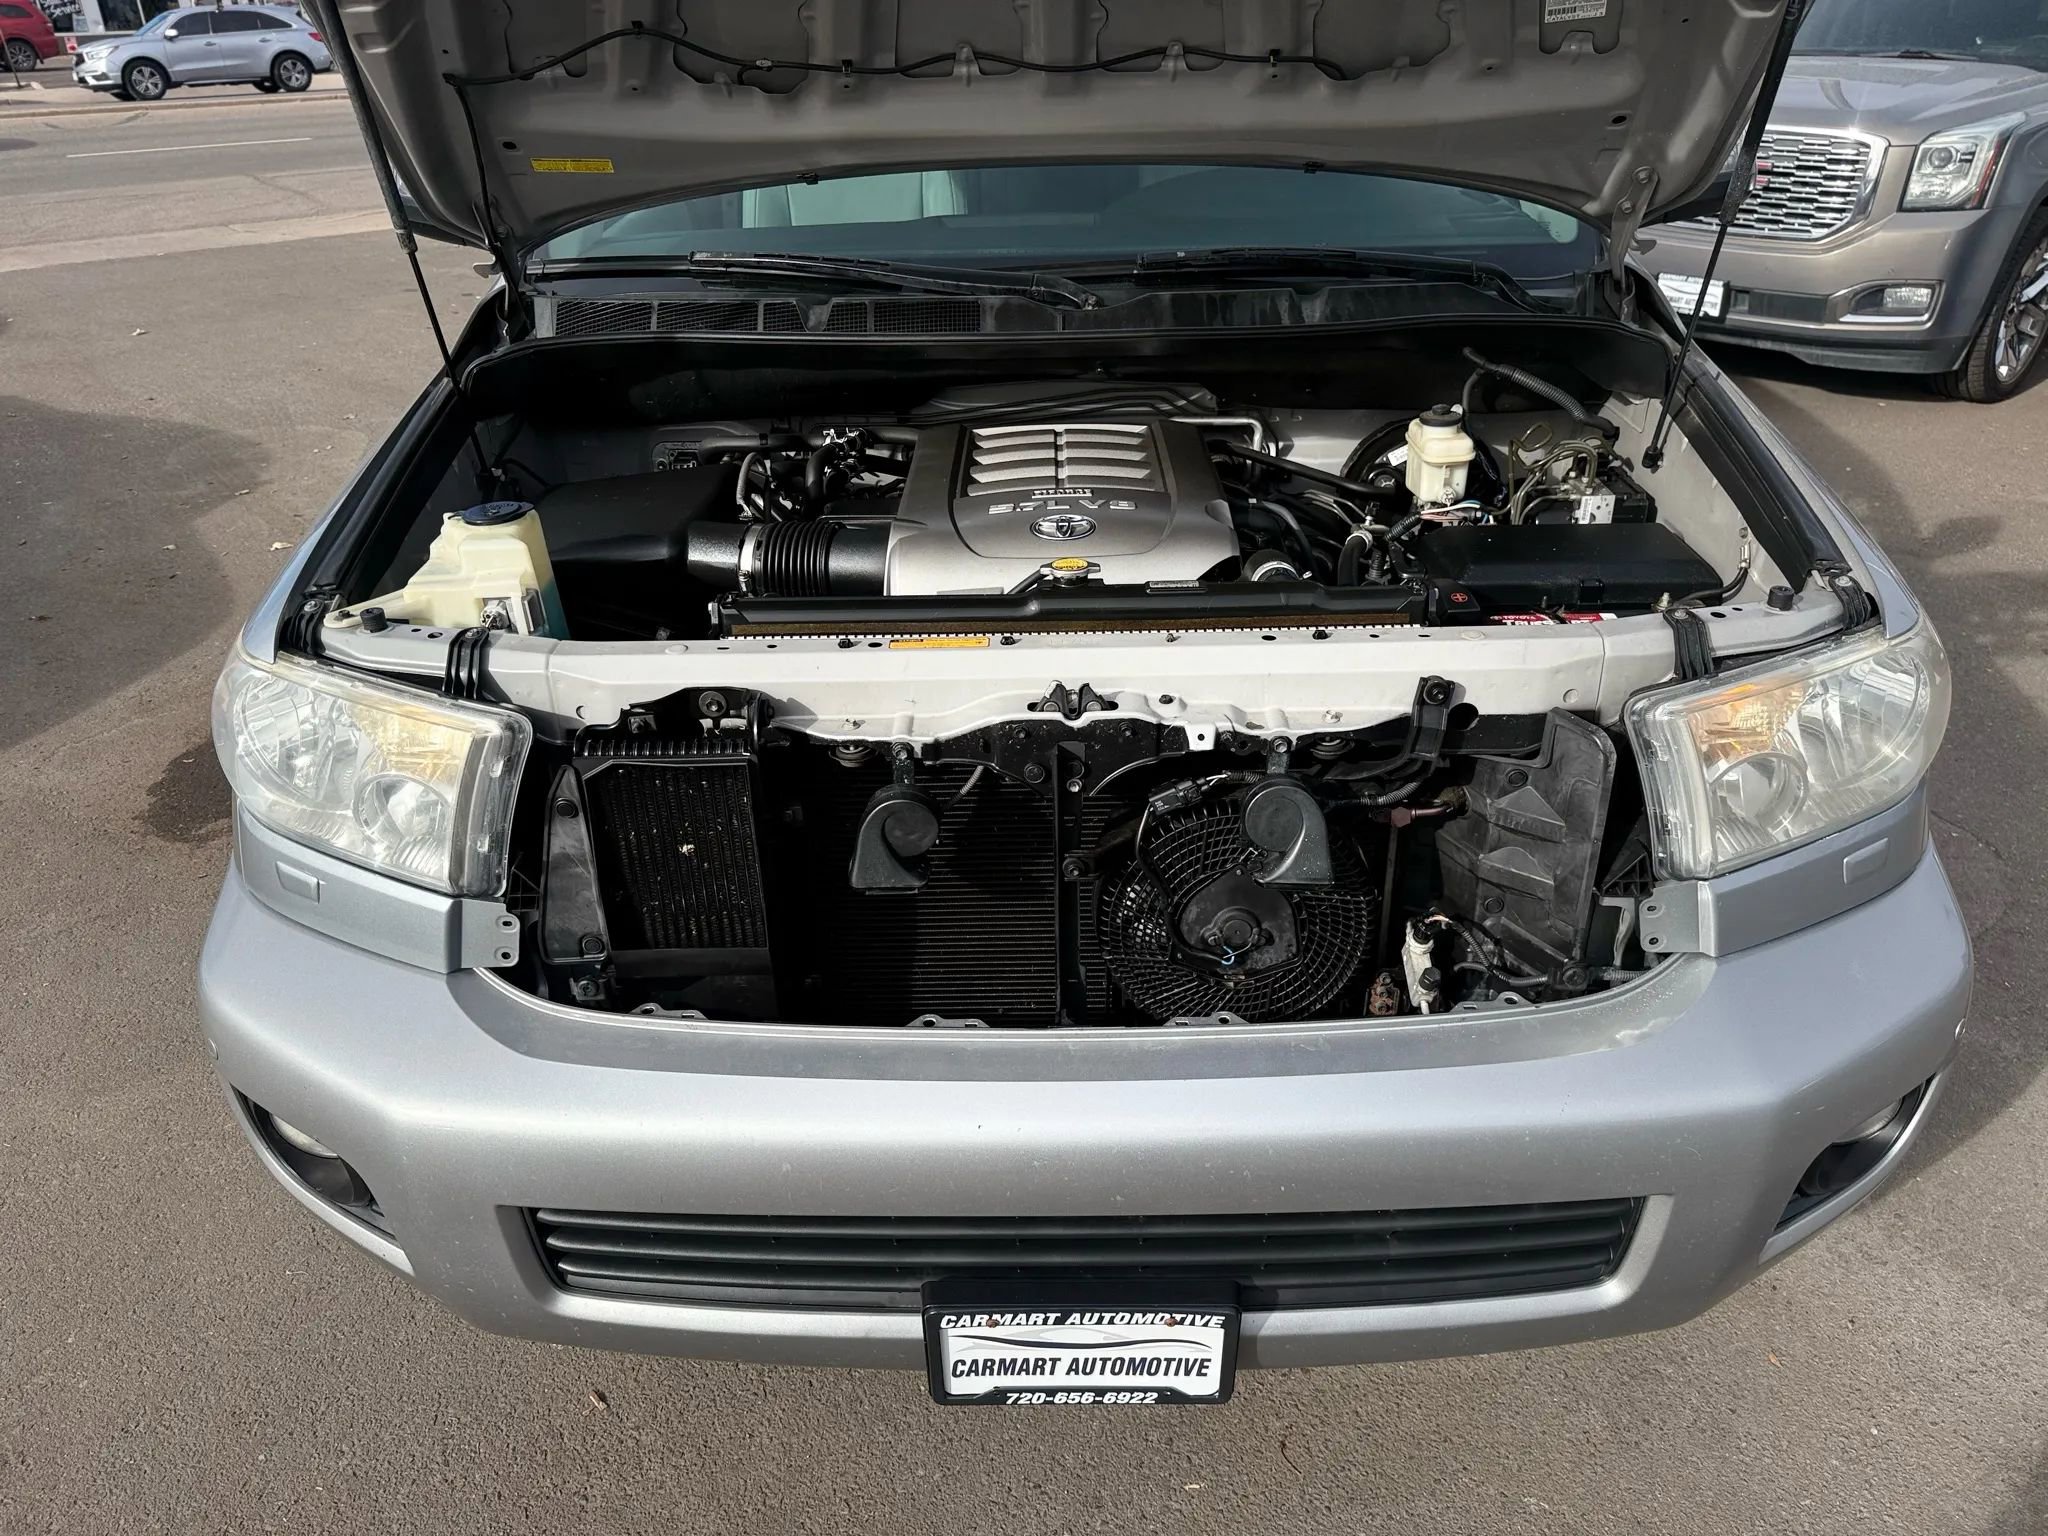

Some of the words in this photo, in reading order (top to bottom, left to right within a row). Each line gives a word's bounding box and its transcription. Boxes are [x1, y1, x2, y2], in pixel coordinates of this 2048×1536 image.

[940, 1313, 1061, 1329] CARMART
[1064, 1312, 1226, 1328] AUTOMOTIVE
[951, 1357, 1062, 1378] CARMART
[1065, 1357, 1213, 1377] AUTOMOTIVE
[1005, 1391, 1159, 1405] 720-656-6922
